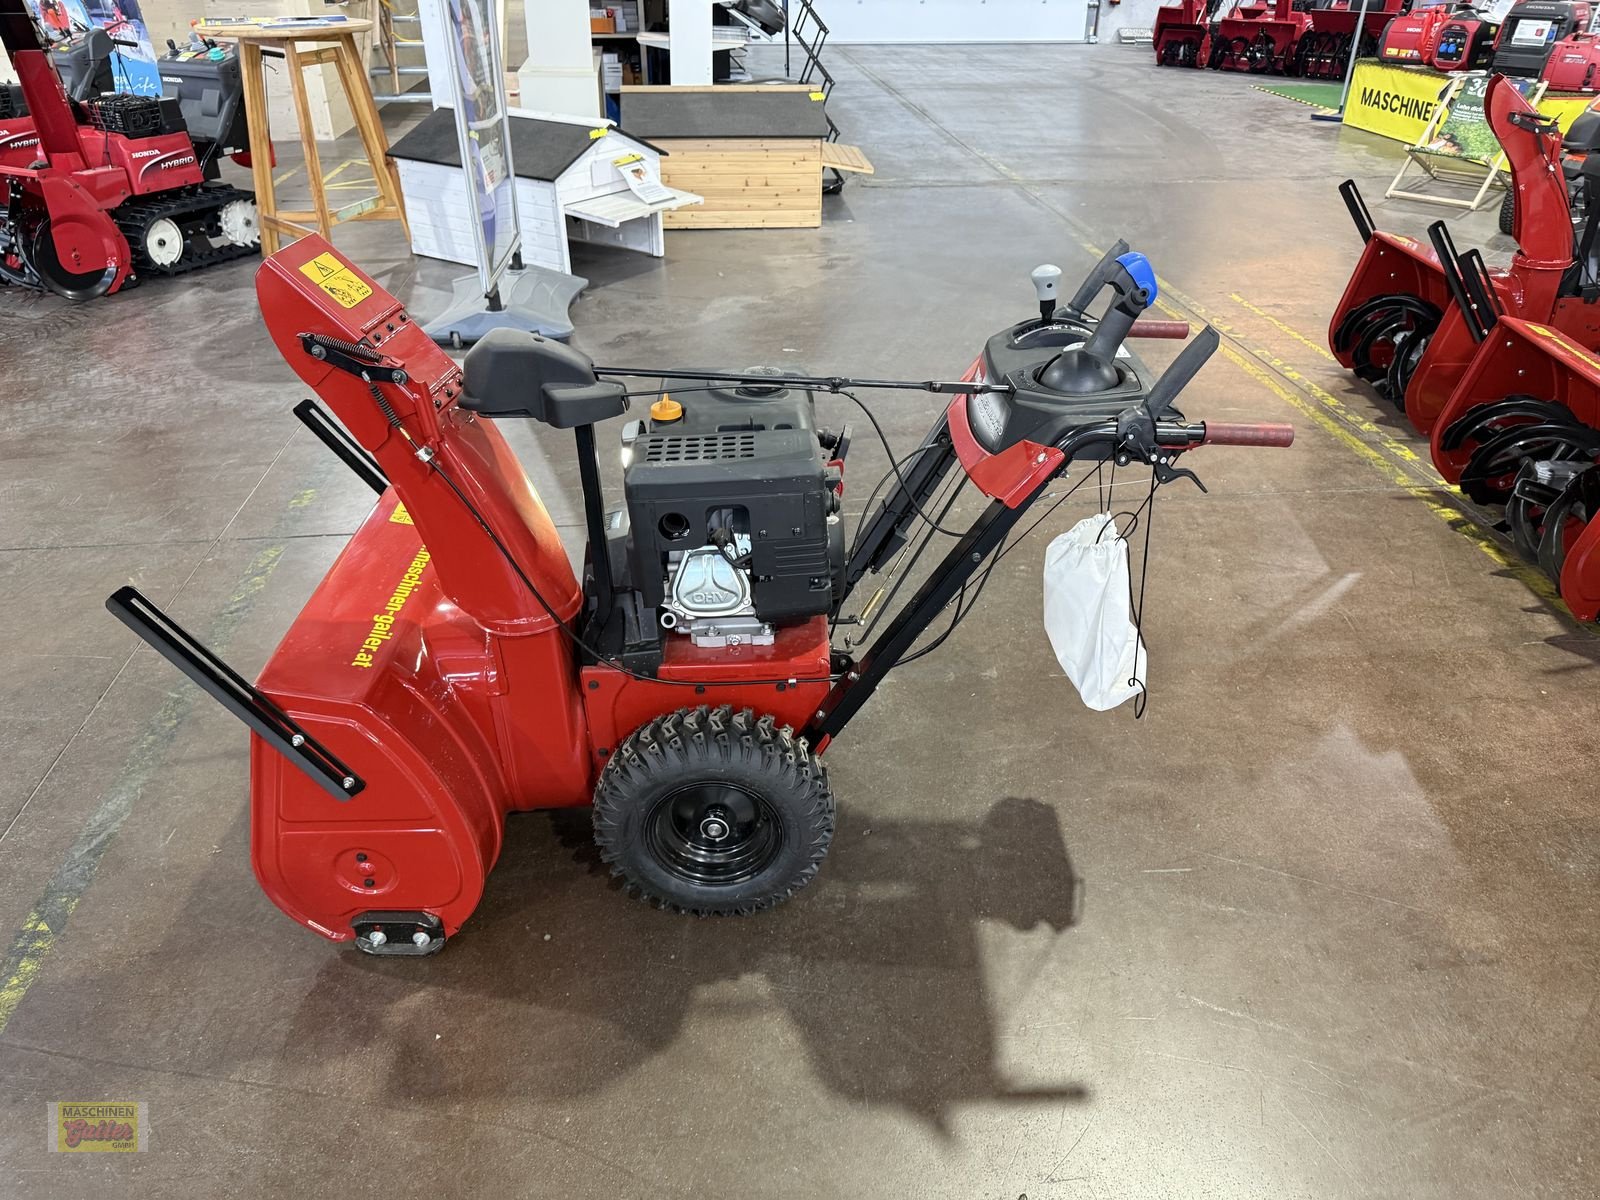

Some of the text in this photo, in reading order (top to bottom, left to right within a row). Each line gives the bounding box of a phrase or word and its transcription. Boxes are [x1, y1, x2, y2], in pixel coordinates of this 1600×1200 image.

[131, 149, 160, 158] HONDA
[161, 156, 194, 169] HYBRID
[693, 592, 728, 604] OHV
[352, 544, 431, 668] .maschinen-gailer.at
